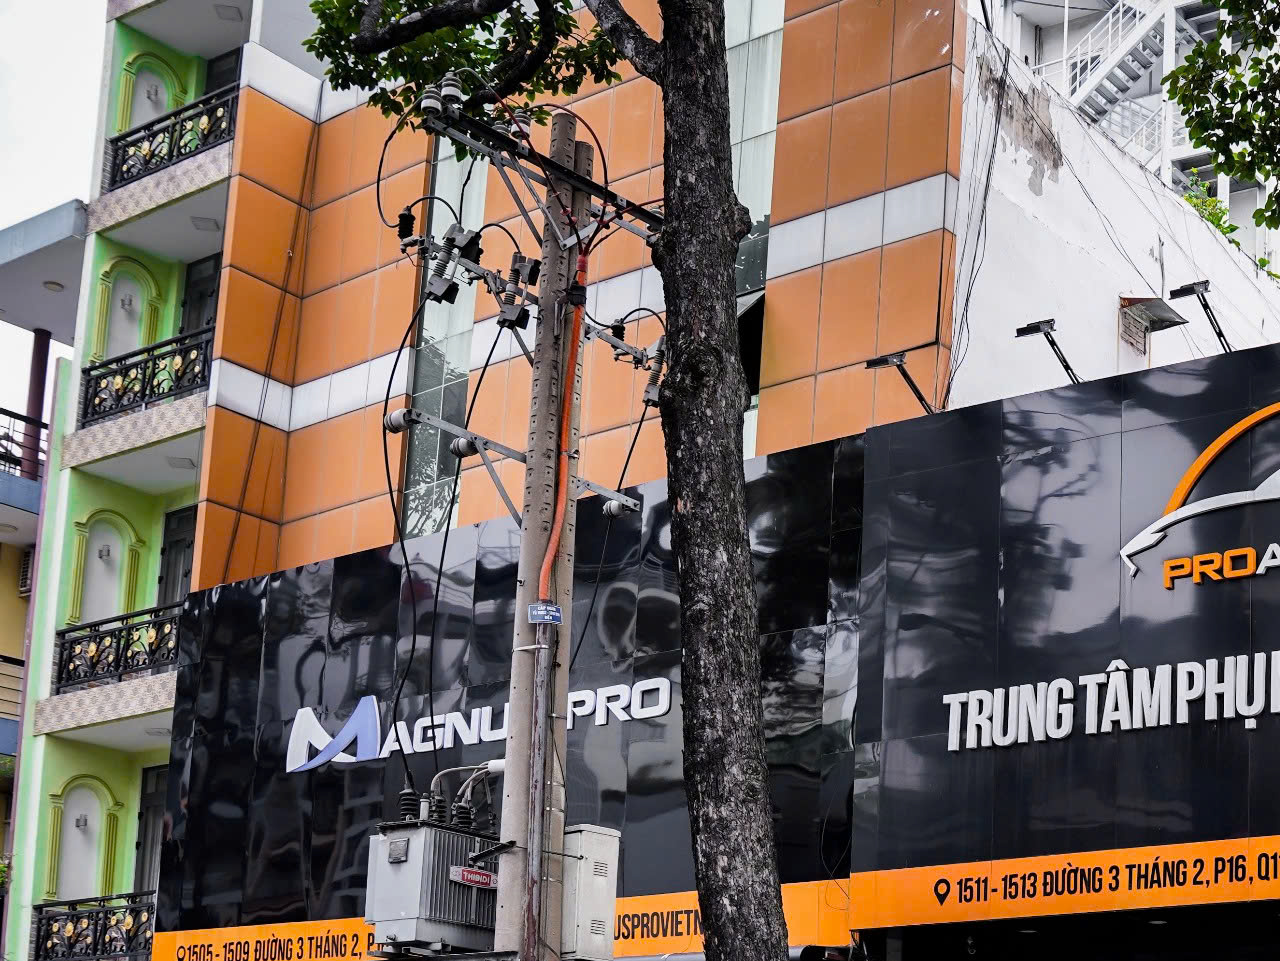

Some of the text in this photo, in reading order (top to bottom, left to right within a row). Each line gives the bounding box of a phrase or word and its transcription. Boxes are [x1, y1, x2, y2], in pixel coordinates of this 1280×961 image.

[285, 676, 672, 773] MAGNU PRO
[942, 677, 1074, 752] TRUNG
[1079, 658, 1172, 735] TÂM
[1176, 651, 1267, 729] PHỤ
[956, 876, 989, 903] 1511
[1001, 872, 1038, 901] 1513
[1042, 862, 1102, 897] ĐƯỜNG
[1108, 864, 1120, 891] 3
[1125, 856, 1188, 891] THÁNG
[254, 933, 293, 961] ĐƯỜNG
[296, 937, 304, 960] 3
[308, 929, 347, 959] THÁNG
